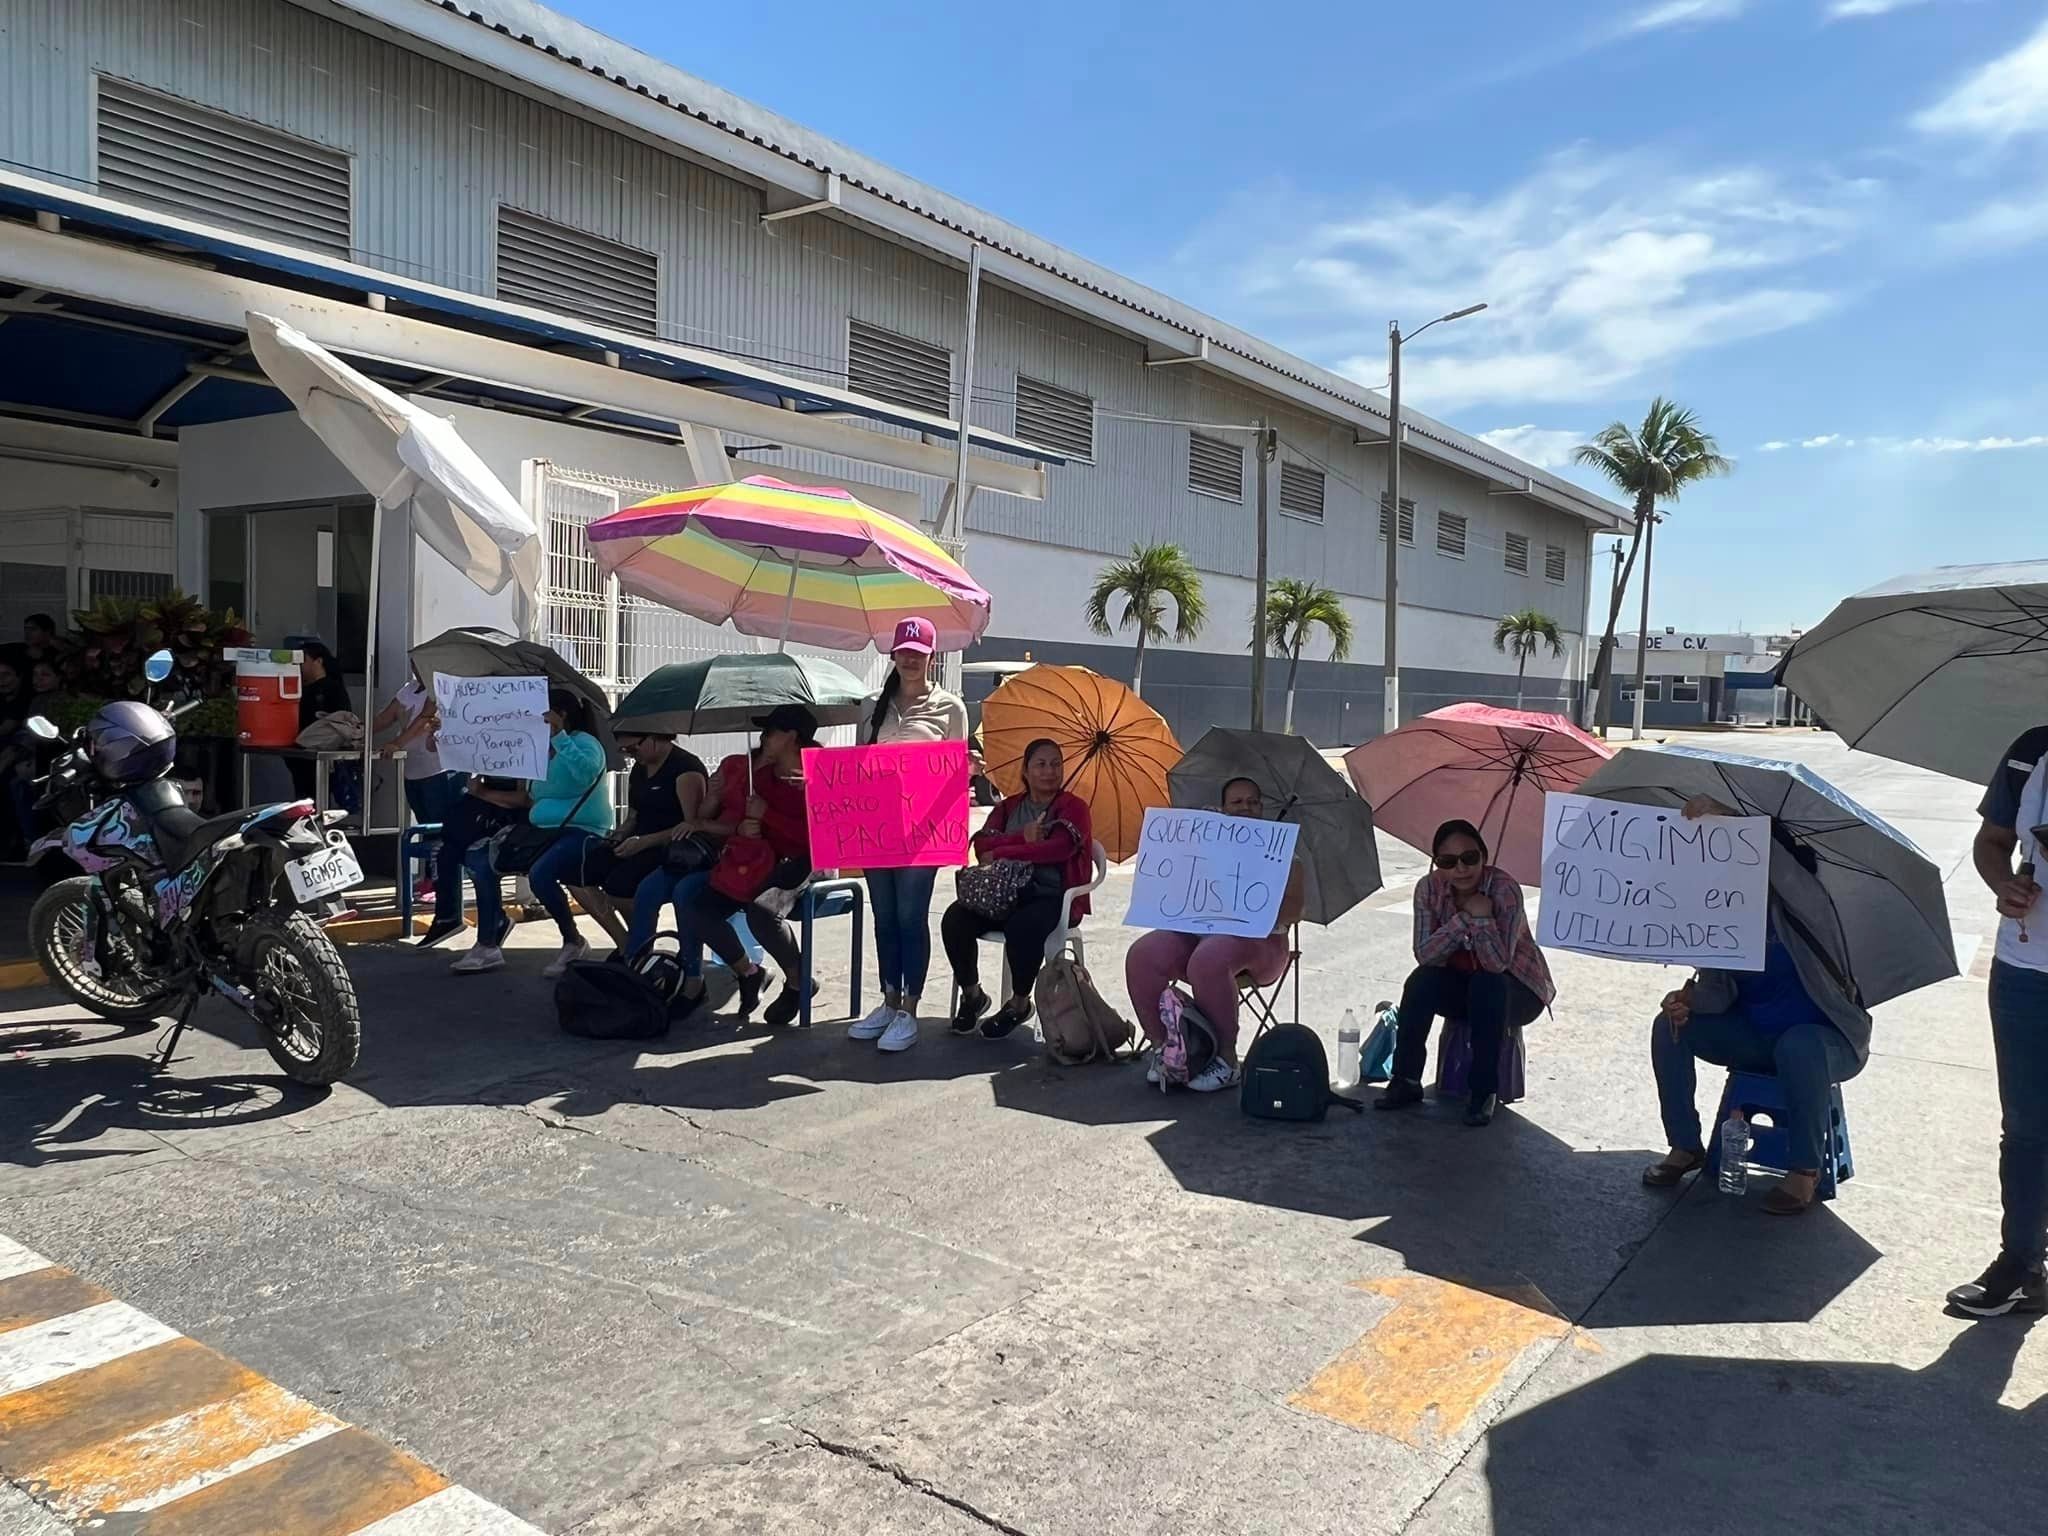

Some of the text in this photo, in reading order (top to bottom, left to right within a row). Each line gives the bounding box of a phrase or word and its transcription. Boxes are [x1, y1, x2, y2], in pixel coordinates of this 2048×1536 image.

[1646, 637, 1662, 649] DE
[1683, 637, 1708, 650] C.V.
[927, 754, 961, 776] UN
[898, 791, 917, 812] Y
[1138, 852, 1174, 878] LO
[1554, 861, 1582, 897] 90
[1704, 888, 1745, 909] en
